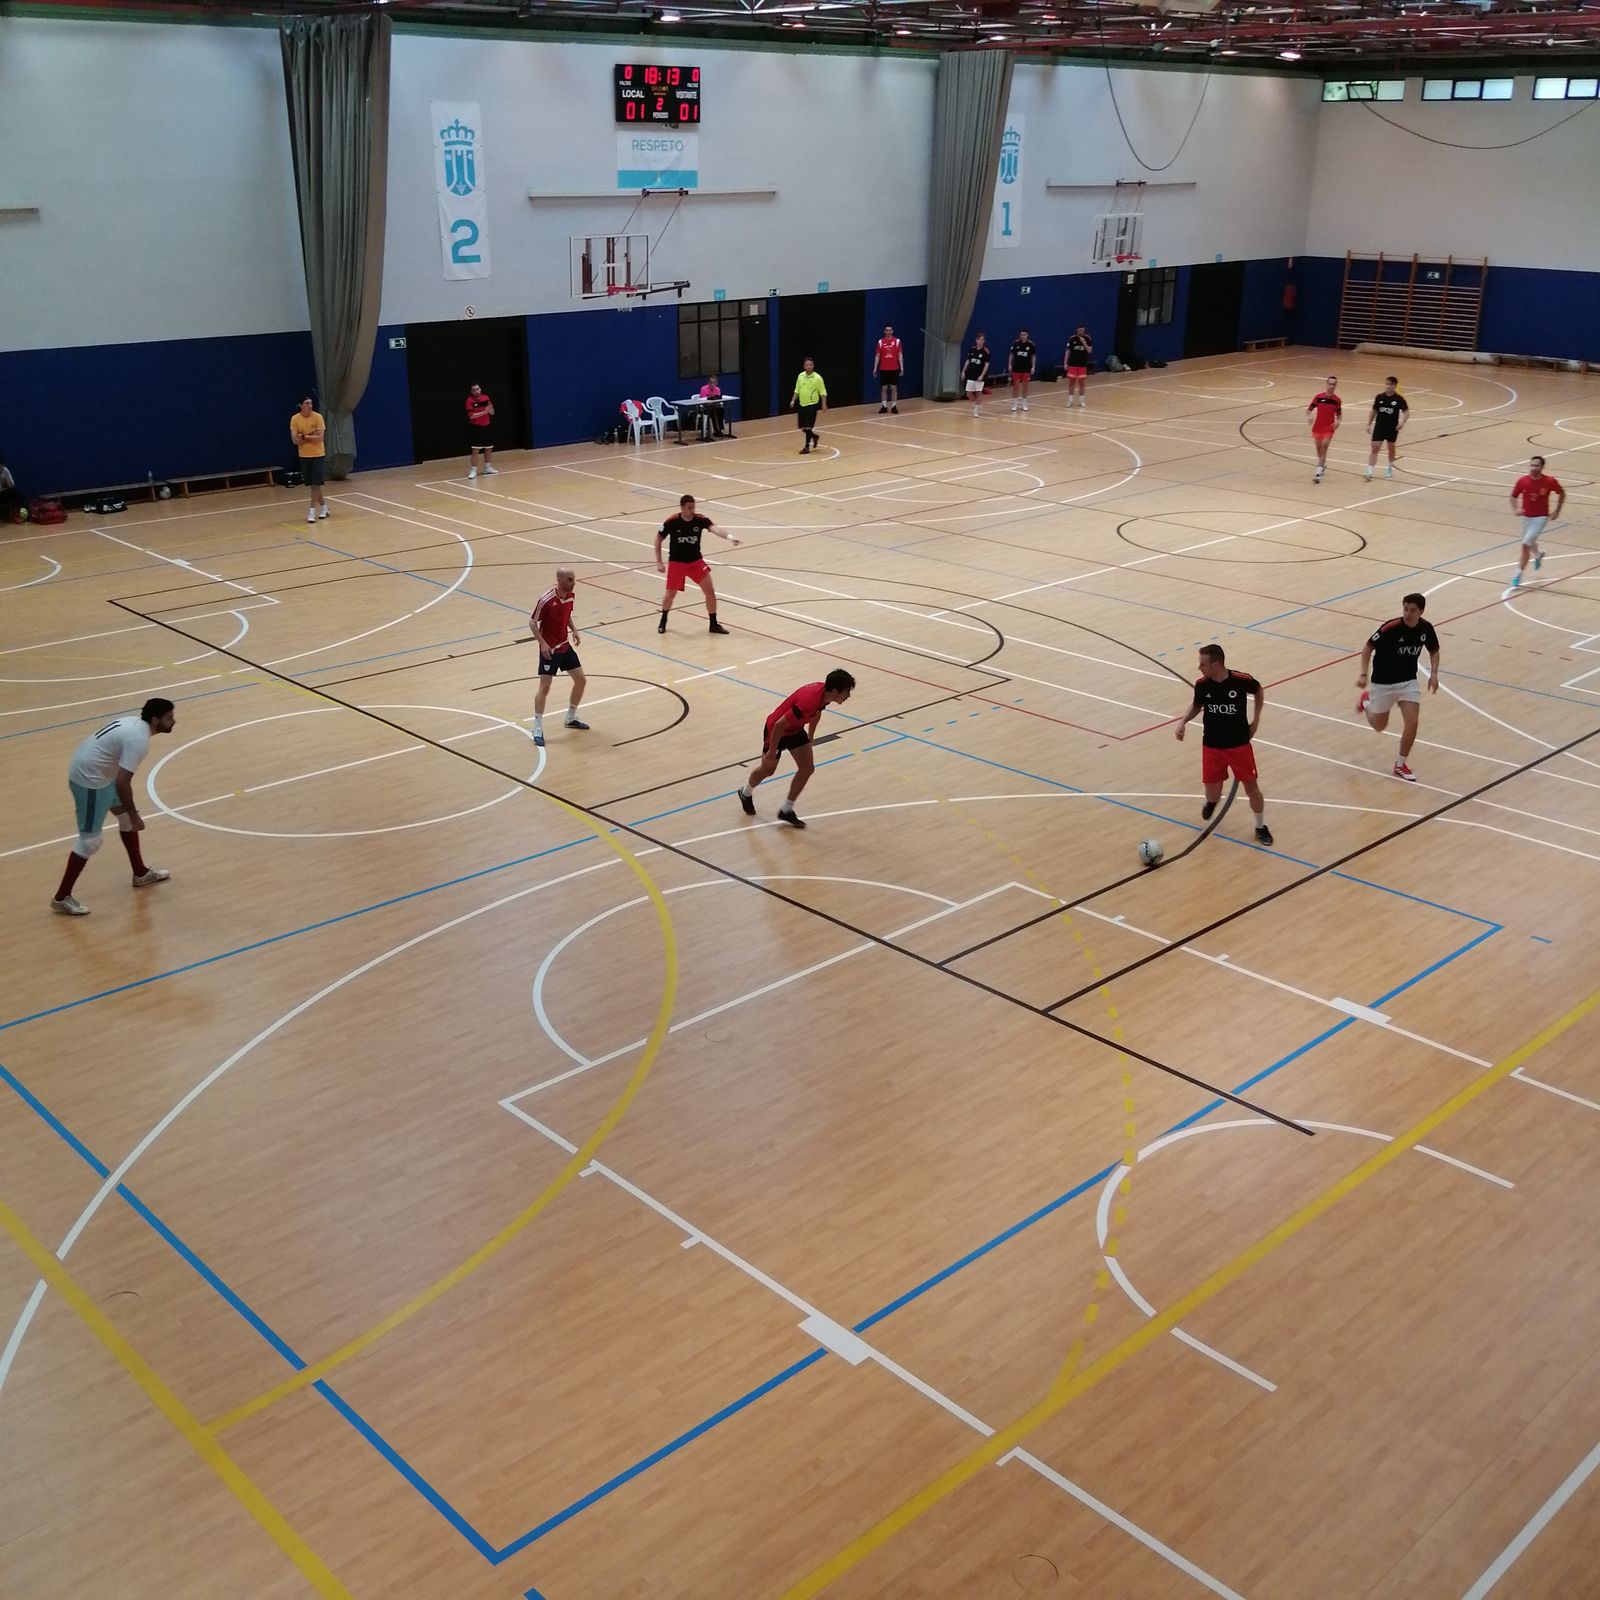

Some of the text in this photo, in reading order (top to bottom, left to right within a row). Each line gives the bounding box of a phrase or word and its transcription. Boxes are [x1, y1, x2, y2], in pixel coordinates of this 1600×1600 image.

[624, 65, 632, 80] 0
[644, 66, 680, 86] 18:13
[692, 69, 699, 81] 0
[622, 89, 645, 98] LOCAL
[626, 101, 645, 120] 01
[657, 97, 664, 111] 2
[679, 103, 698, 121] 01
[631, 139, 684, 152] RESPETO
[1002, 201, 1012, 236] 1
[450, 218, 481, 264] 2
[1207, 703, 1237, 715] SPQR
